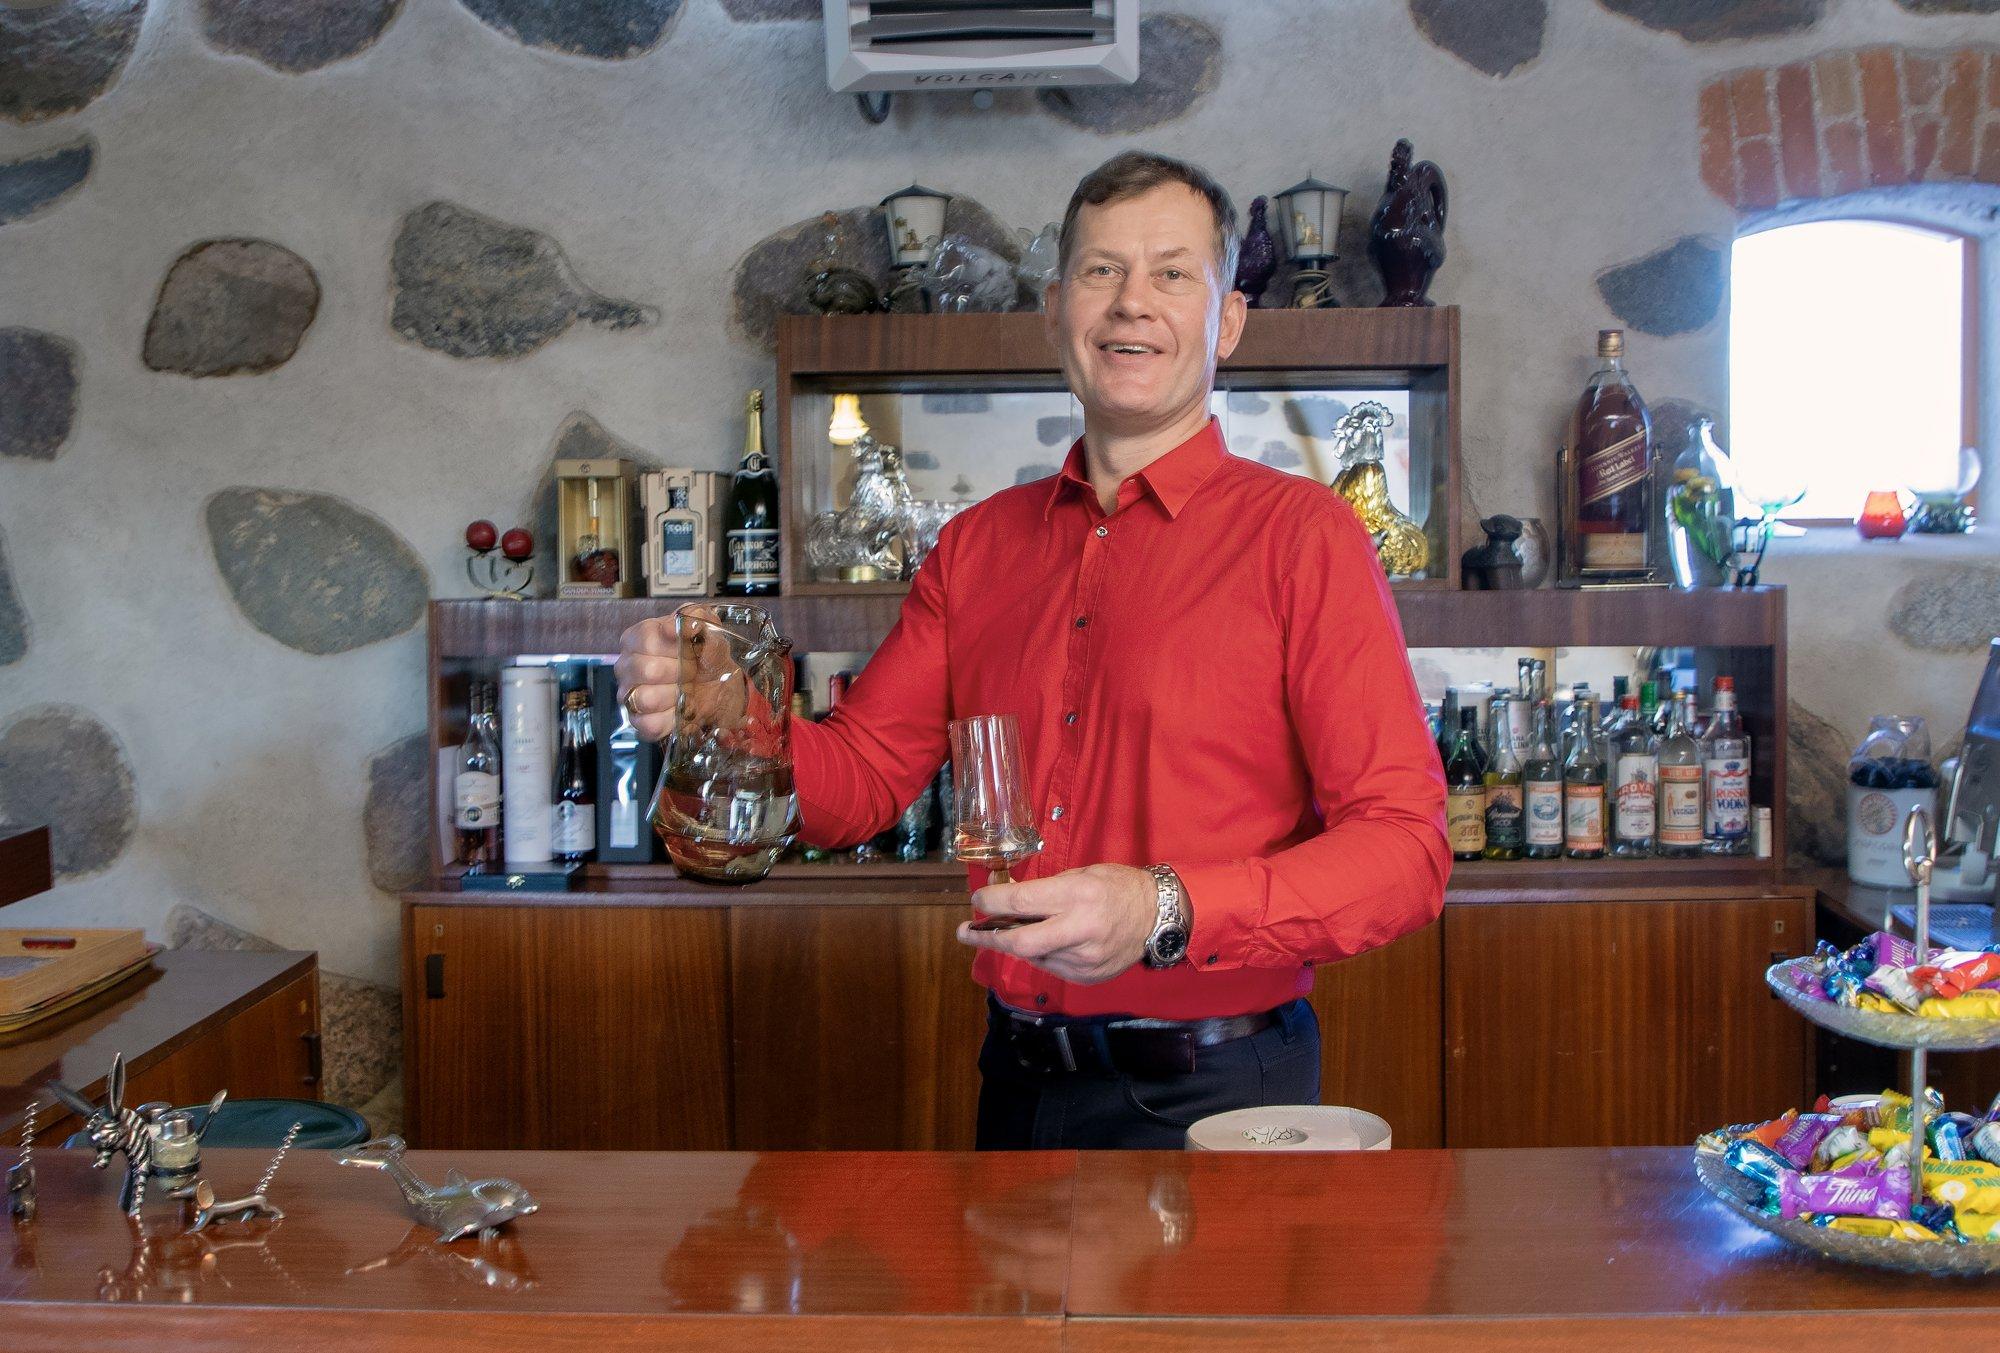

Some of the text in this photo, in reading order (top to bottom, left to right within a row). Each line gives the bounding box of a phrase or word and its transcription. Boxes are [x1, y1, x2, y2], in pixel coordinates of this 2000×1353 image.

[1599, 465, 1615, 478] Red
[1615, 455, 1636, 471] Label
[1825, 1177, 1879, 1208] Tiina
